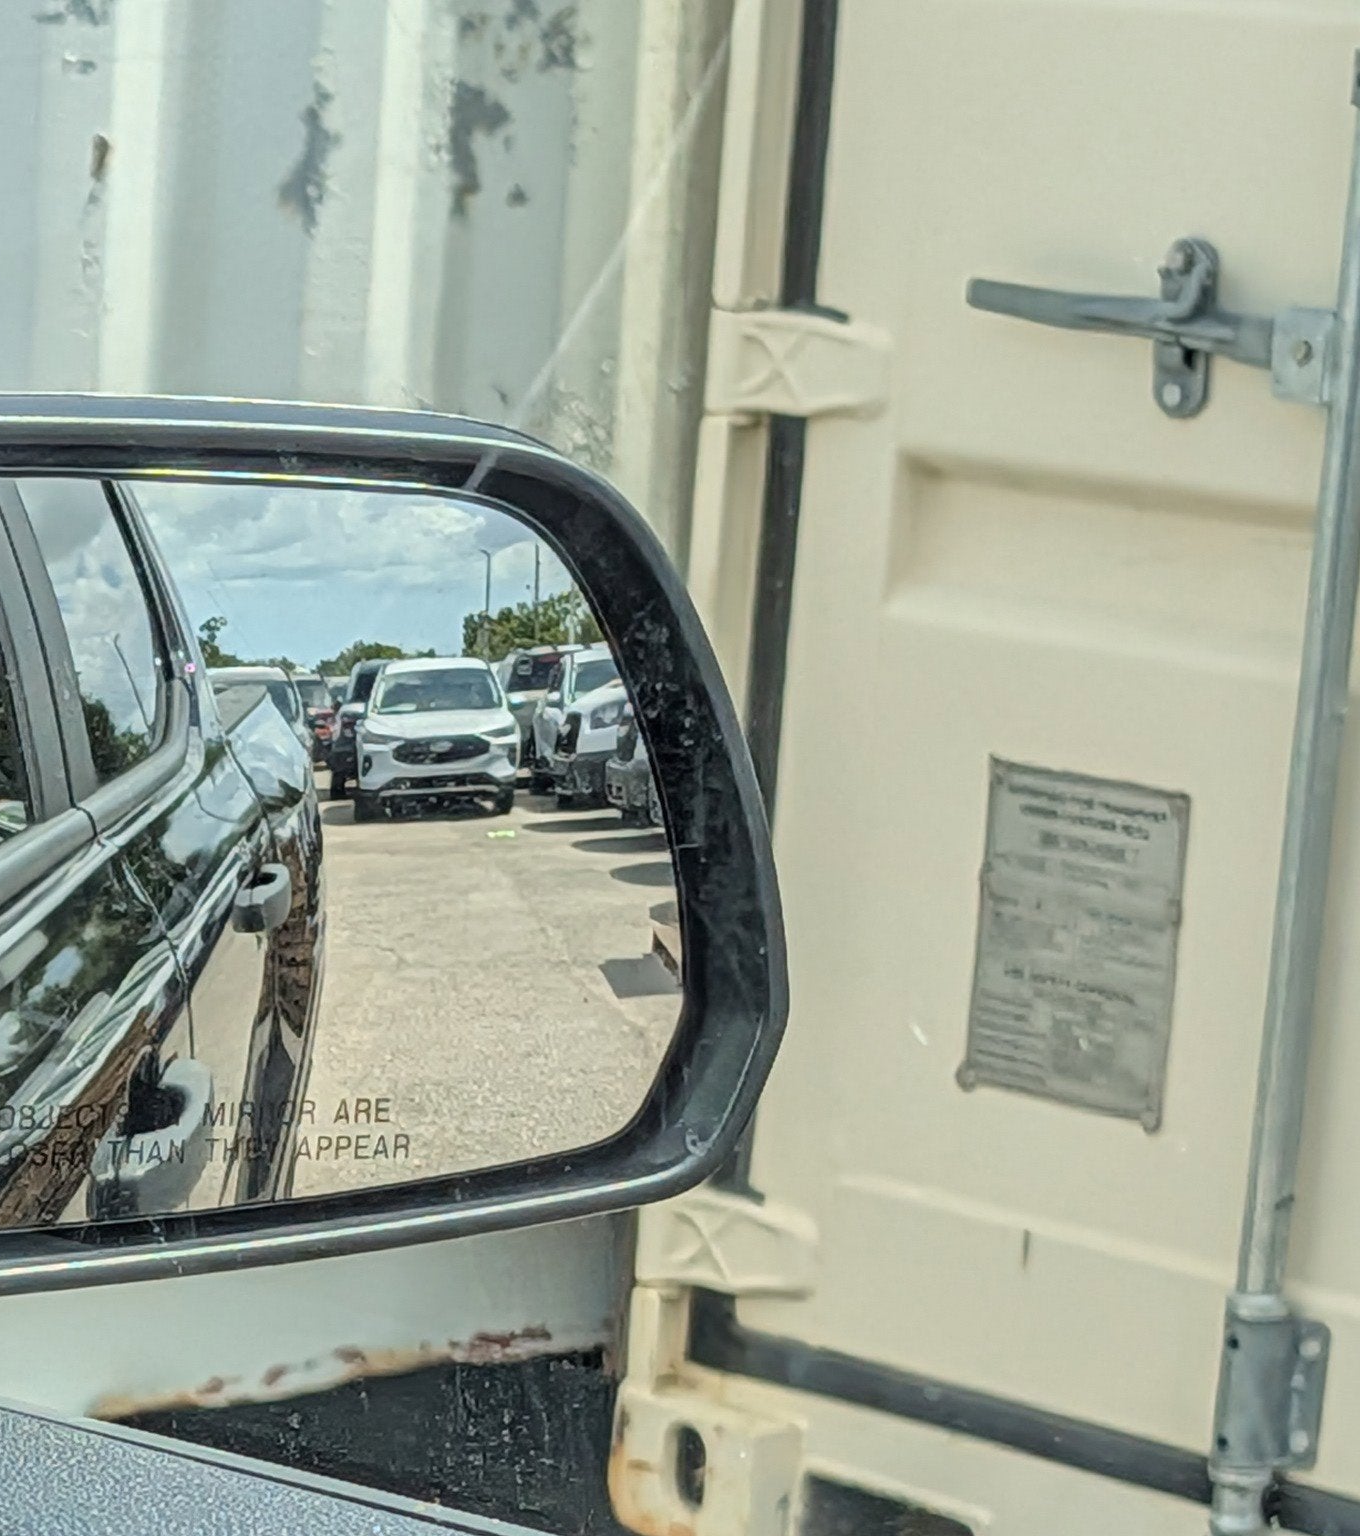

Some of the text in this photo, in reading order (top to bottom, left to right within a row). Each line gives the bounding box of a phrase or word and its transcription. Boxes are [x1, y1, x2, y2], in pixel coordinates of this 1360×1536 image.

[202, 1099, 316, 1127] MIROR
[333, 1098, 391, 1124] ARE
[107, 1138, 186, 1165] THAN
[295, 1133, 411, 1160] APPEAR
